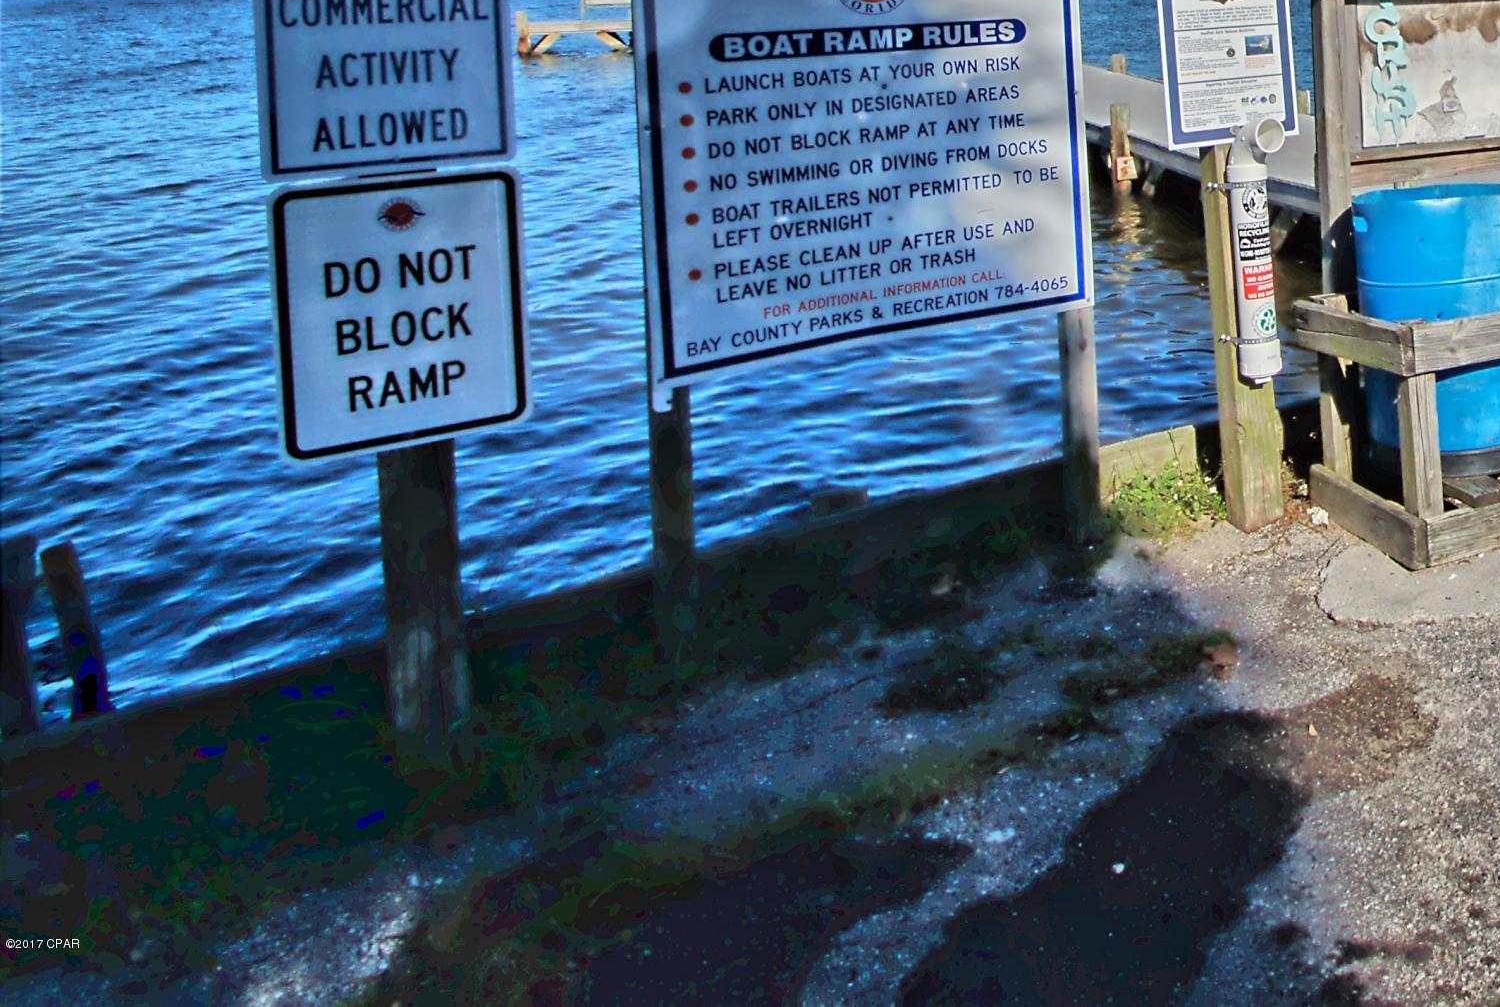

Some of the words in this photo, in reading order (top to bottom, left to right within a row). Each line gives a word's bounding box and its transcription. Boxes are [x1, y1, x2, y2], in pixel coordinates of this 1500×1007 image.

[724, 33, 813, 59] BOAT
[824, 28, 913, 53] RAMP
[922, 21, 1016, 46] RULES
[315, 48, 460, 89] ACTIVITY
[704, 73, 784, 94] LAUNCH
[794, 68, 851, 87] BOATS
[859, 66, 880, 82] AT
[889, 62, 935, 79] YOUR
[943, 59, 978, 75] OWN
[986, 56, 1020, 72] RISK
[707, 107, 758, 126] PARK
[768, 102, 816, 121] ONLY
[826, 100, 843, 115] IN
[852, 91, 957, 113] DESIGNATED
[965, 85, 1020, 104] AREAS
[312, 108, 468, 152] ALLOWED
[708, 141, 735, 159] DO
[745, 136, 781, 155] NOT
[791, 130, 850, 151] BLOCK
[859, 125, 910, 143] RAMP
[917, 122, 937, 137] AT
[946, 117, 980, 135] ANY
[989, 113, 1025, 130] TIME
[710, 173, 737, 191] NO
[747, 162, 840, 187] SWIMMING
[850, 158, 873, 175] OR
[882, 151, 938, 172] DIVING
[946, 146, 990, 164] FROM
[998, 139, 1047, 158] DOCKS
[712, 203, 760, 224] BOAT
[770, 191, 860, 216] TRAILERS
[868, 185, 902, 203] NOT
[910, 173, 1001, 198] PERMITTED
[1013, 170, 1032, 184] TO
[1040, 166, 1059, 182] BE
[713, 227, 760, 248] LEFT
[770, 212, 873, 240] OVERNIGHT
[714, 253, 790, 279] PLEASE
[800, 243, 860, 266] CLEAN
[869, 238, 892, 255] UP
[901, 229, 955, 250] AFTER
[963, 223, 994, 241] USE
[1003, 218, 1034, 235] AND
[324, 256, 381, 299] DO
[398, 244, 477, 288] NOT
[716, 279, 777, 304] LEAVE
[786, 274, 810, 292] NO
[821, 263, 881, 286] LITTER
[890, 259, 912, 274] OR
[921, 248, 975, 269] TRASH
[1244, 264, 1273, 274] WARN
[687, 336, 721, 357] BAY
[731, 321, 802, 348] COUNTY
[810, 309, 863, 331] PARKS
[871, 306, 883, 319] &
[893, 289, 988, 316] RECREATION
[995, 276, 1068, 300] 784-4065
[764, 304, 791, 319] FOR
[798, 289, 877, 313] ADDITIONAL
[883, 275, 966, 297] INFORMATION
[335, 302, 472, 356] BLOCK
[349, 360, 467, 413] RAMP
